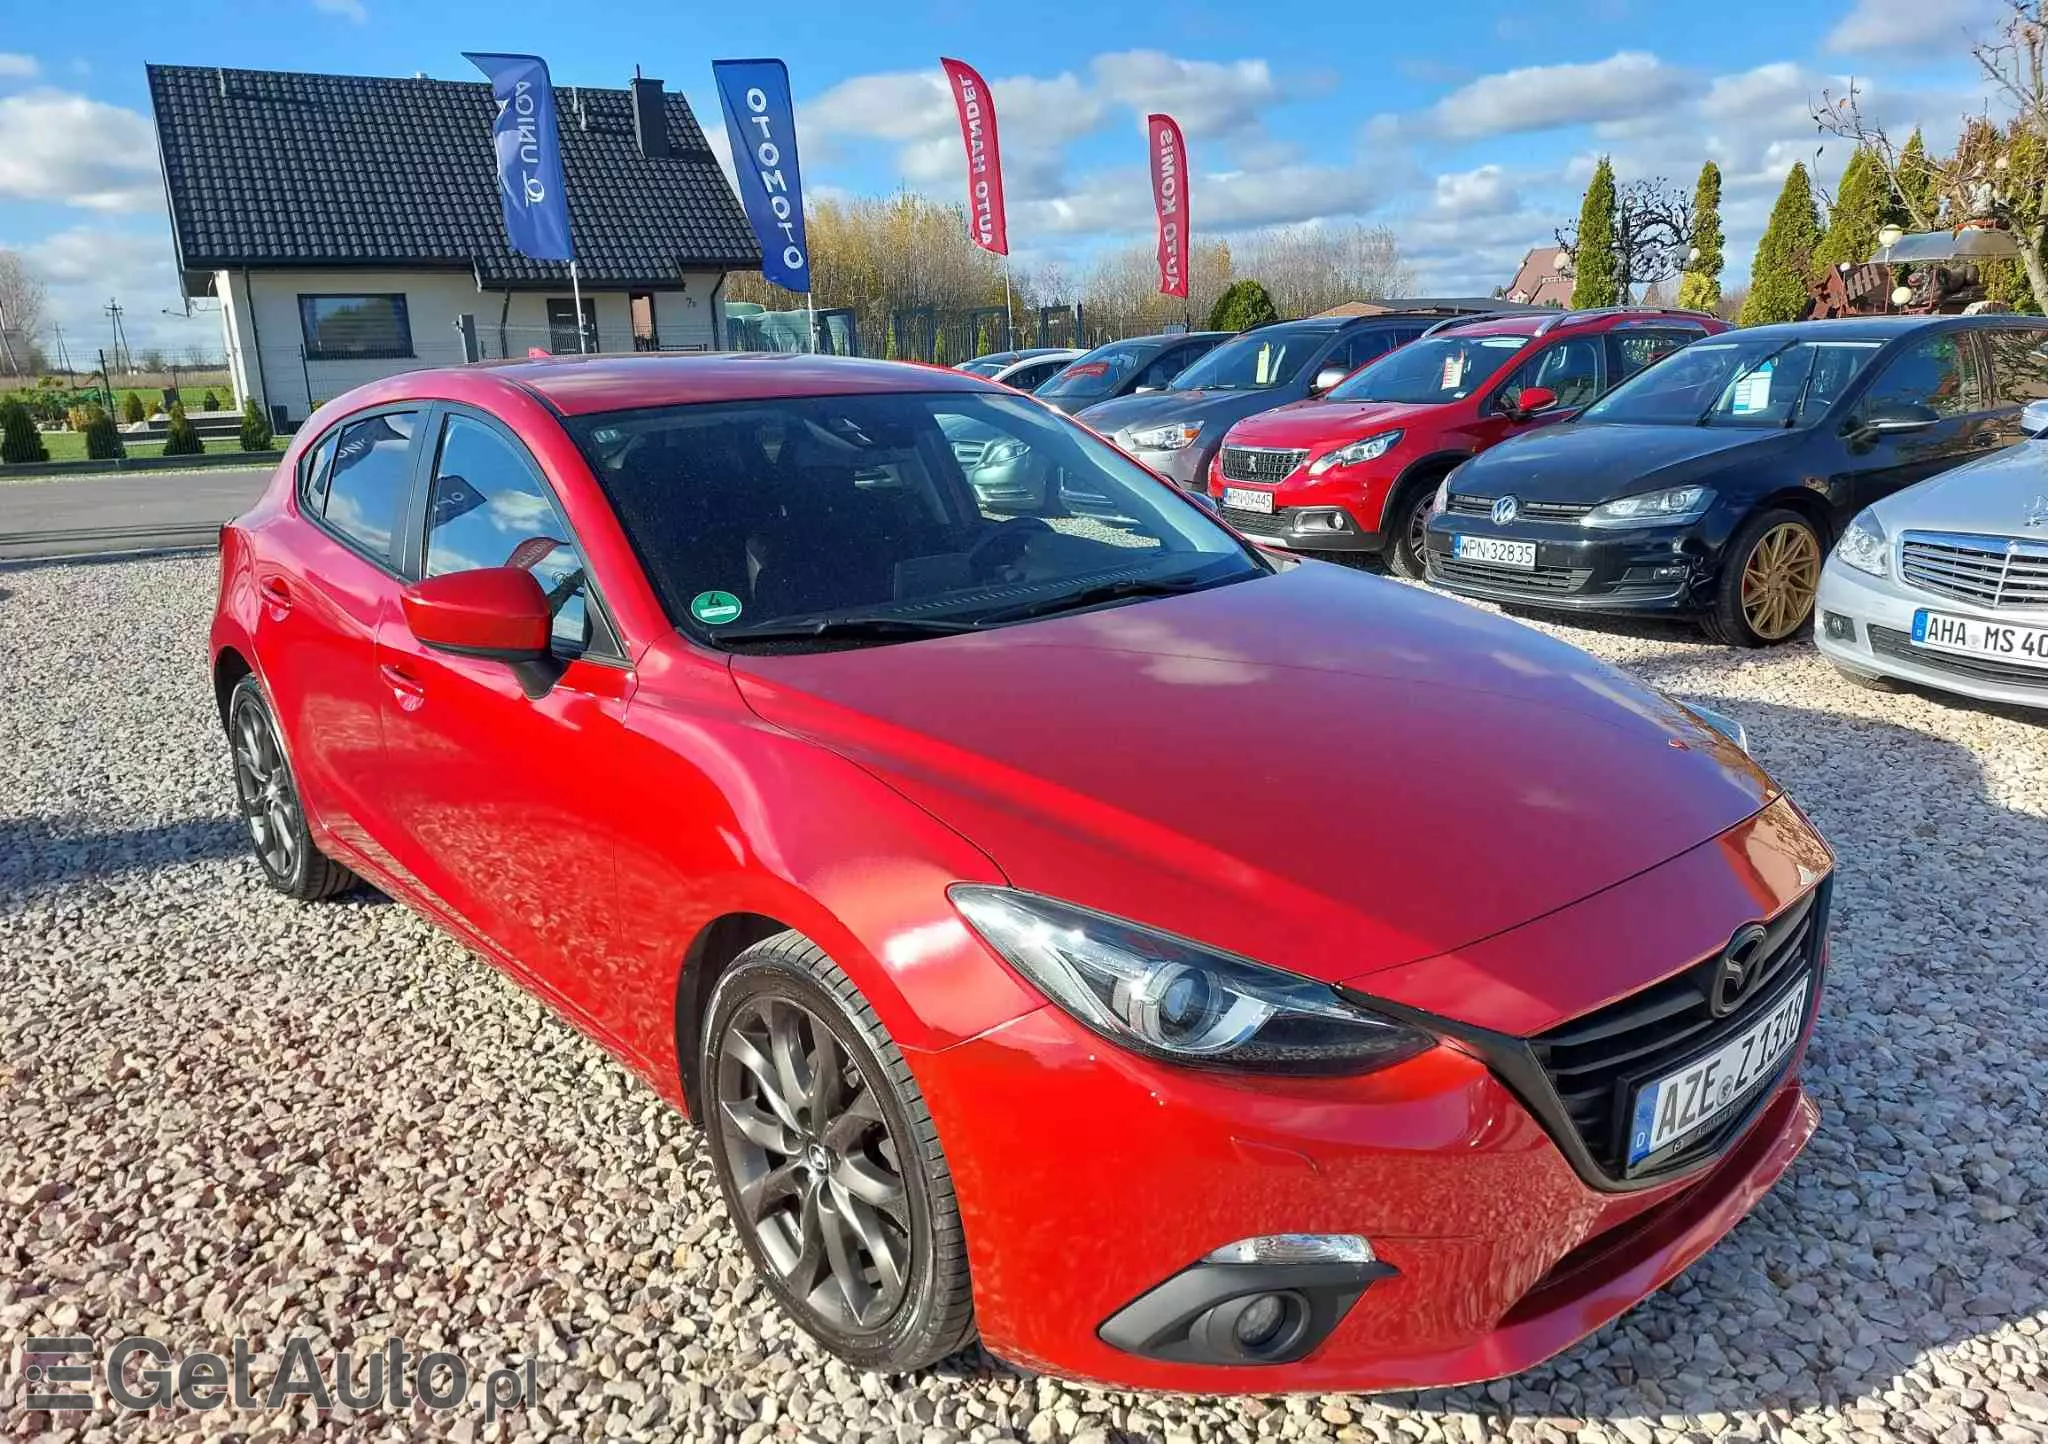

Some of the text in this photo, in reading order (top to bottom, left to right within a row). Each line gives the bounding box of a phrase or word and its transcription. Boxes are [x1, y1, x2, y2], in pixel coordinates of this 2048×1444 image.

[745, 87, 805, 270] OTOMOTO
[1461, 539, 1533, 564] WPN 32835
[1927, 617, 1966, 646] AHA
[1984, 626, 2016, 653] MS
[1655, 1058, 1721, 1141] AZE
[1733, 1034, 1756, 1093] Z
